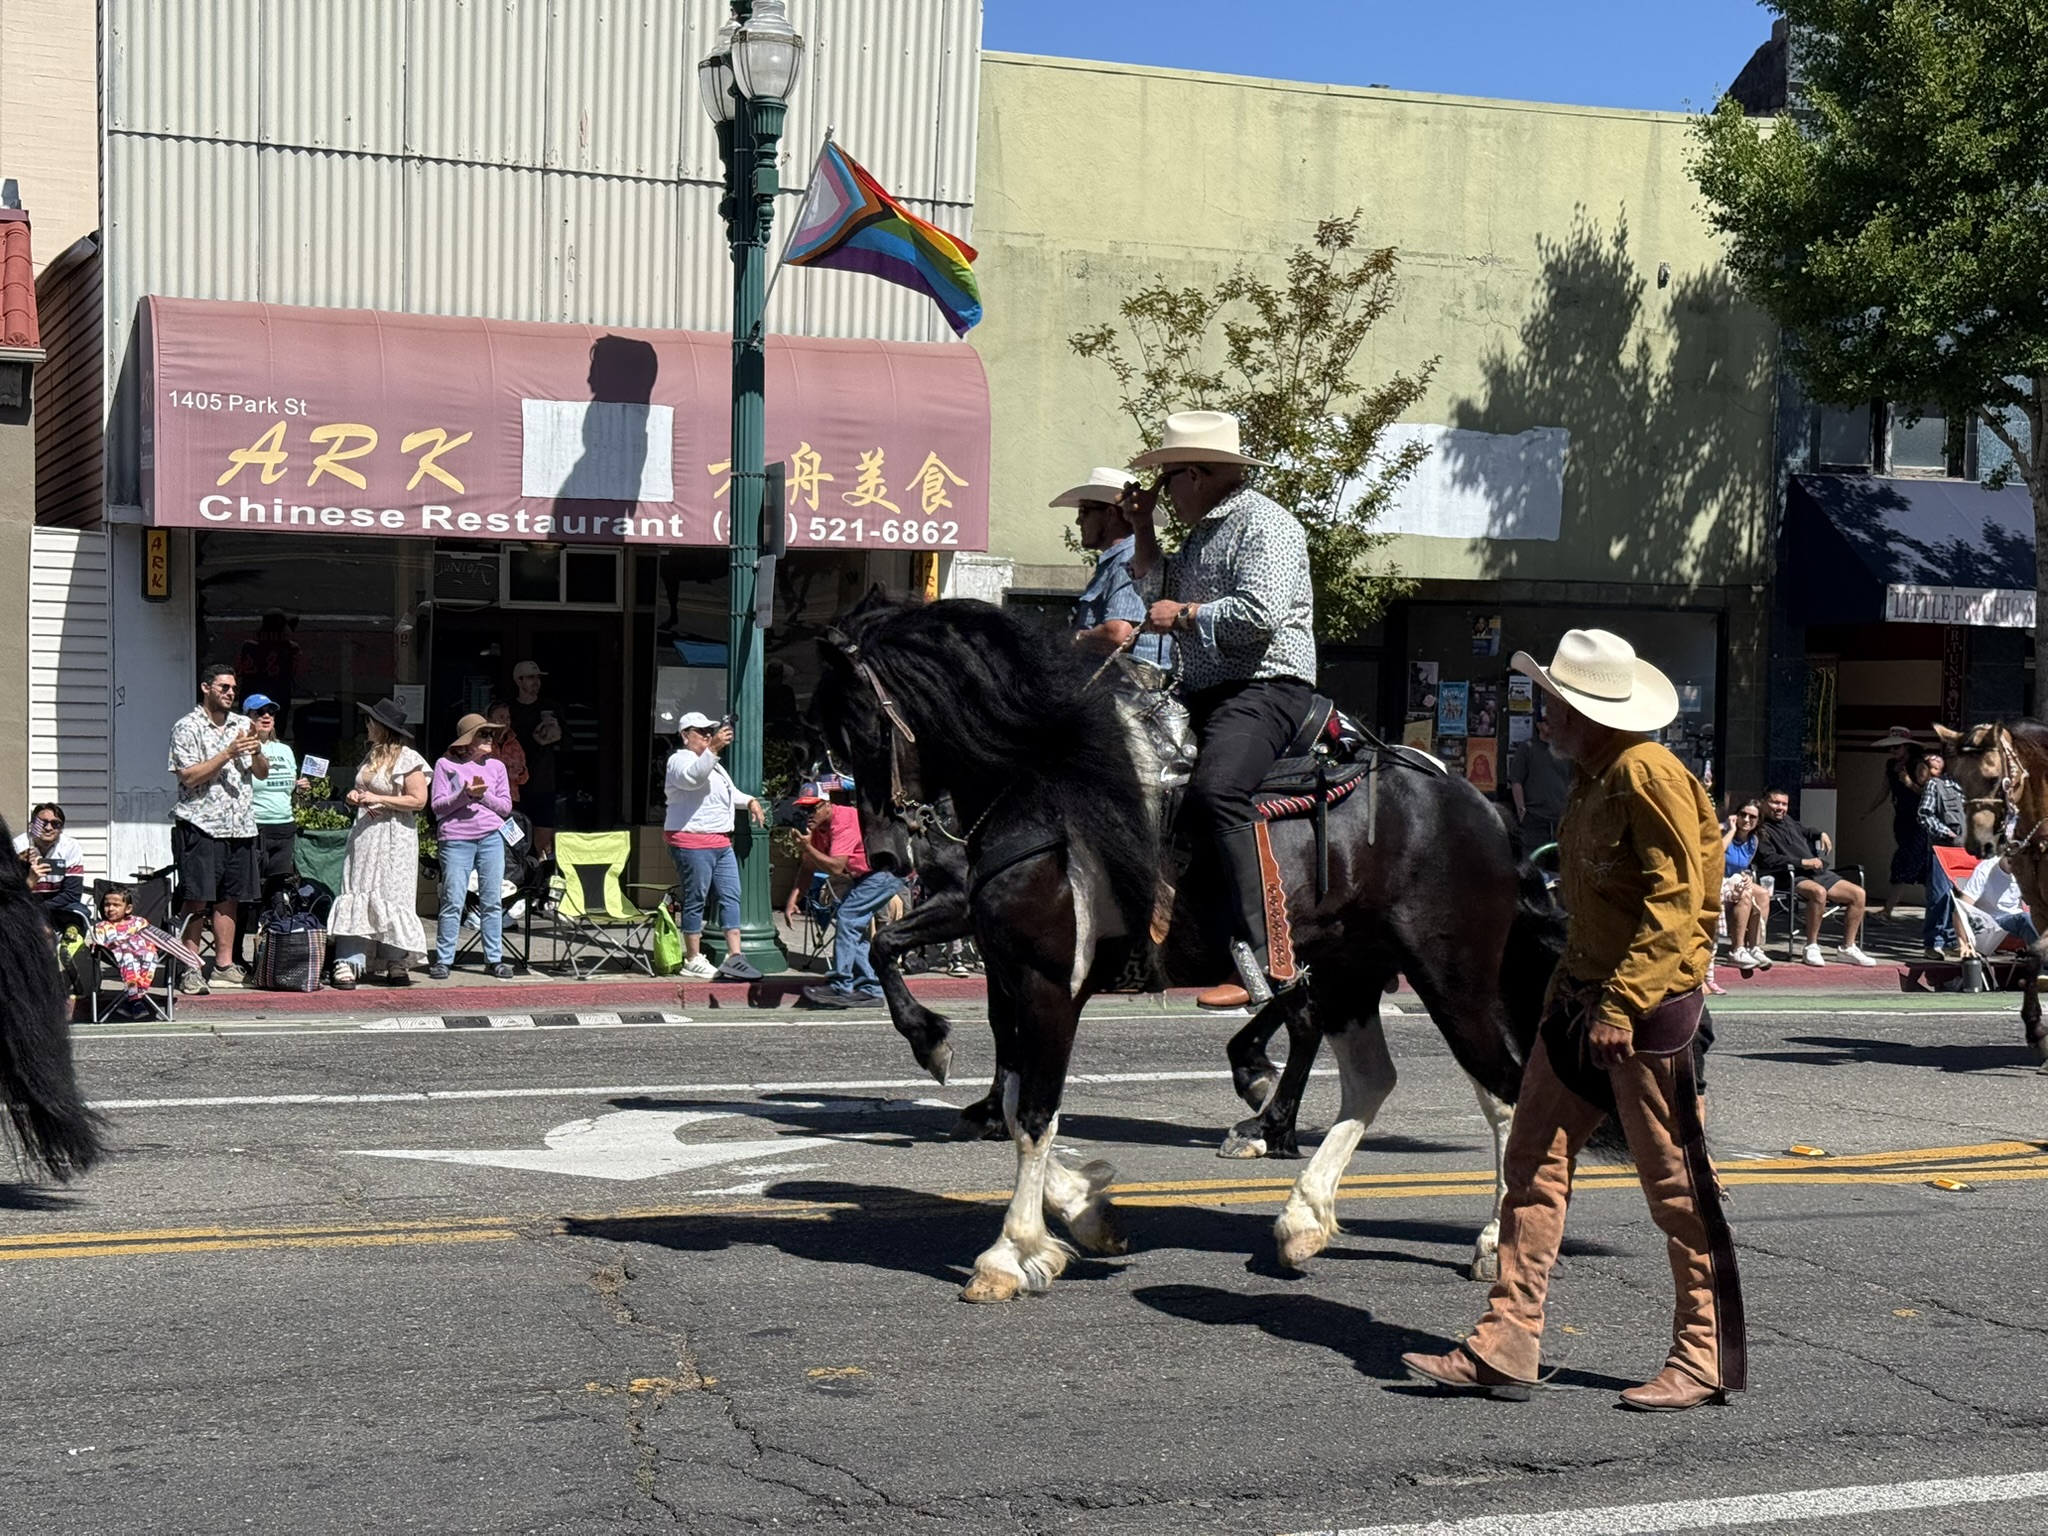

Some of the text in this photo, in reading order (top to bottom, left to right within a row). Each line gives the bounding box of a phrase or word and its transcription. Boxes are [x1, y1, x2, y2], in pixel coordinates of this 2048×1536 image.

[168, 390, 222, 411] 1405
[229, 395, 279, 414] Park
[284, 397, 307, 416] St
[216, 420, 474, 495] ARK
[199, 494, 405, 529] Chinese
[422, 504, 684, 538] Restaurant
[809, 517, 959, 545] 521-6862
[151, 536, 165, 589] ARK
